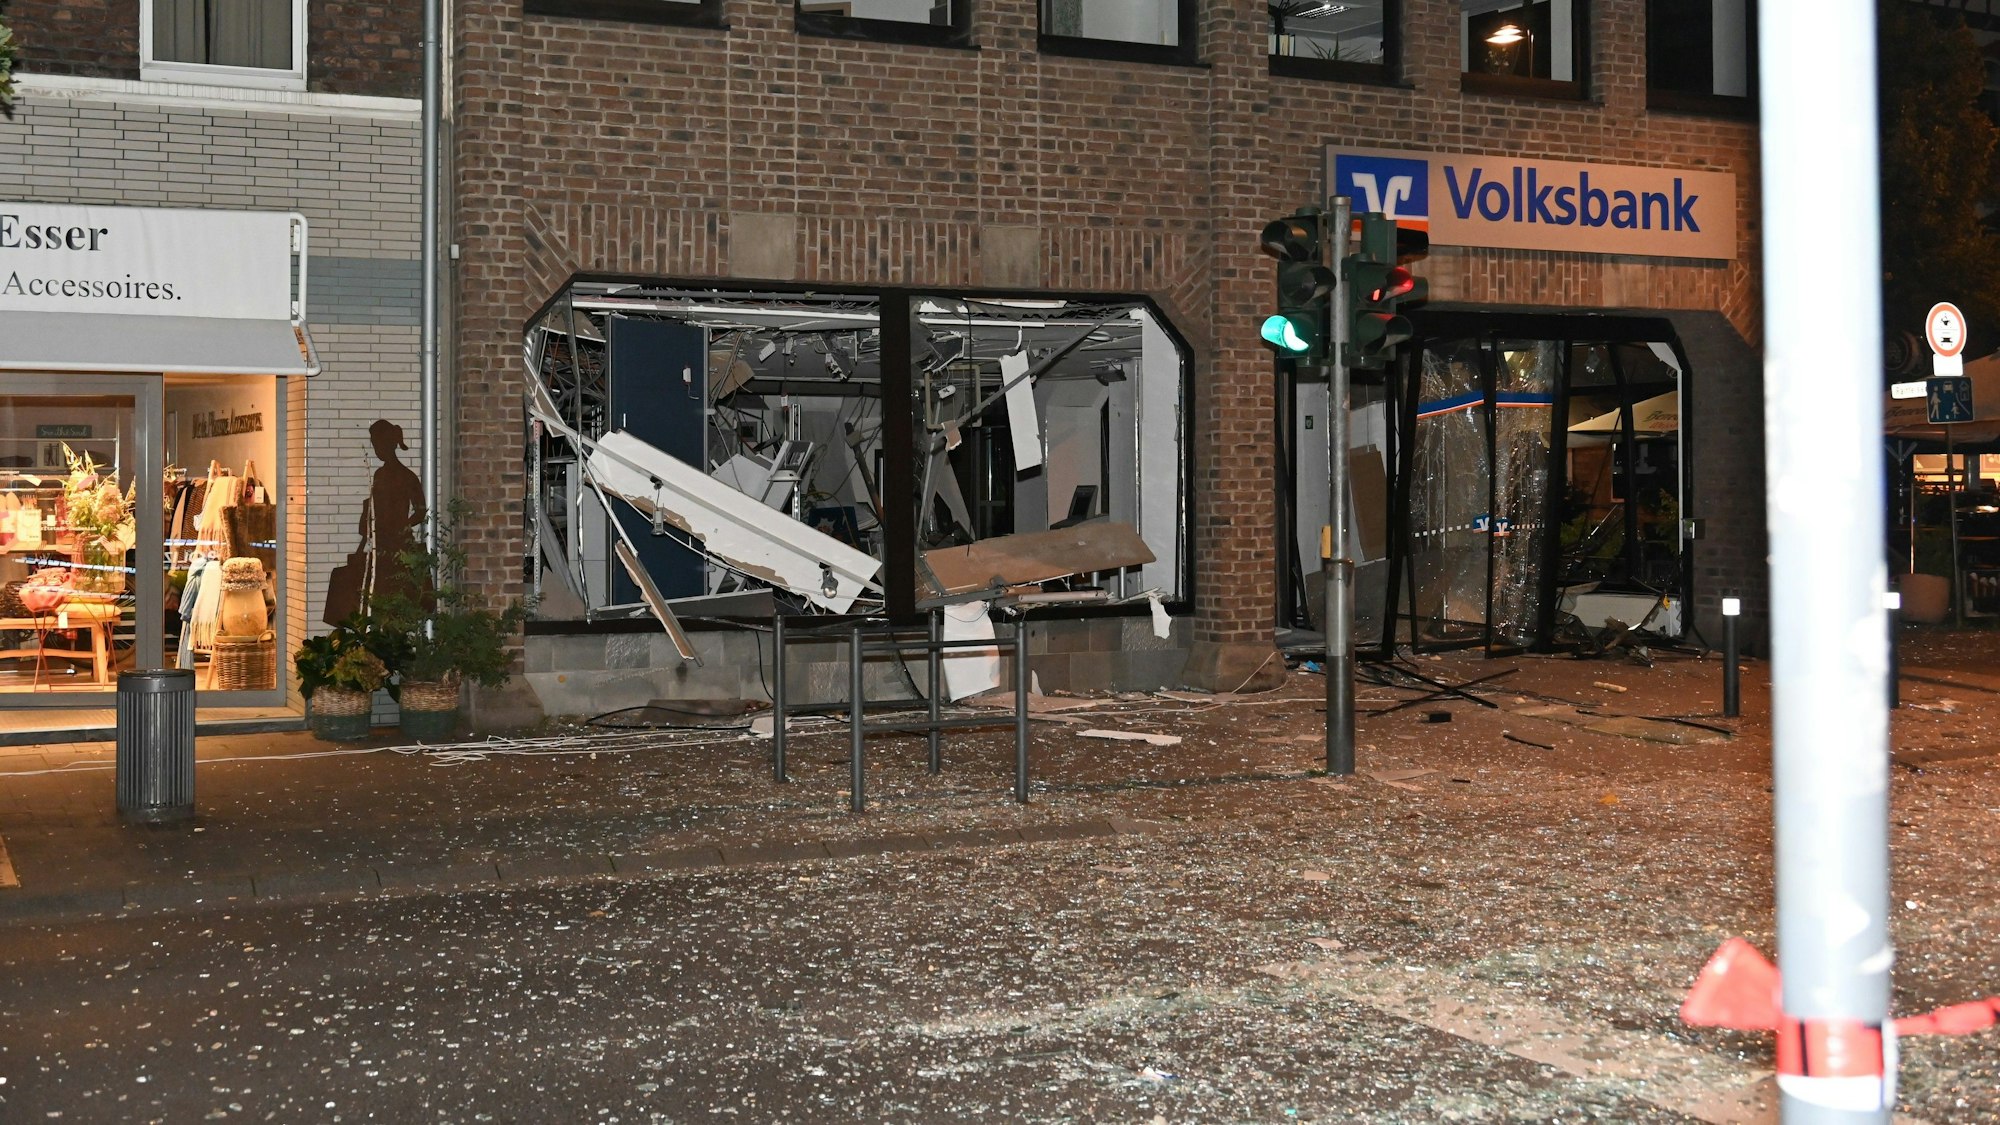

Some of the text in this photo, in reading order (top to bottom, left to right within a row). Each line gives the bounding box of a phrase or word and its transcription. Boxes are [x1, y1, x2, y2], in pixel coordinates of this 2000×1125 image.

[1443, 166, 1701, 233] Volksbank
[0, 214, 109, 252] Esser
[2, 270, 182, 301] Accessoires.
